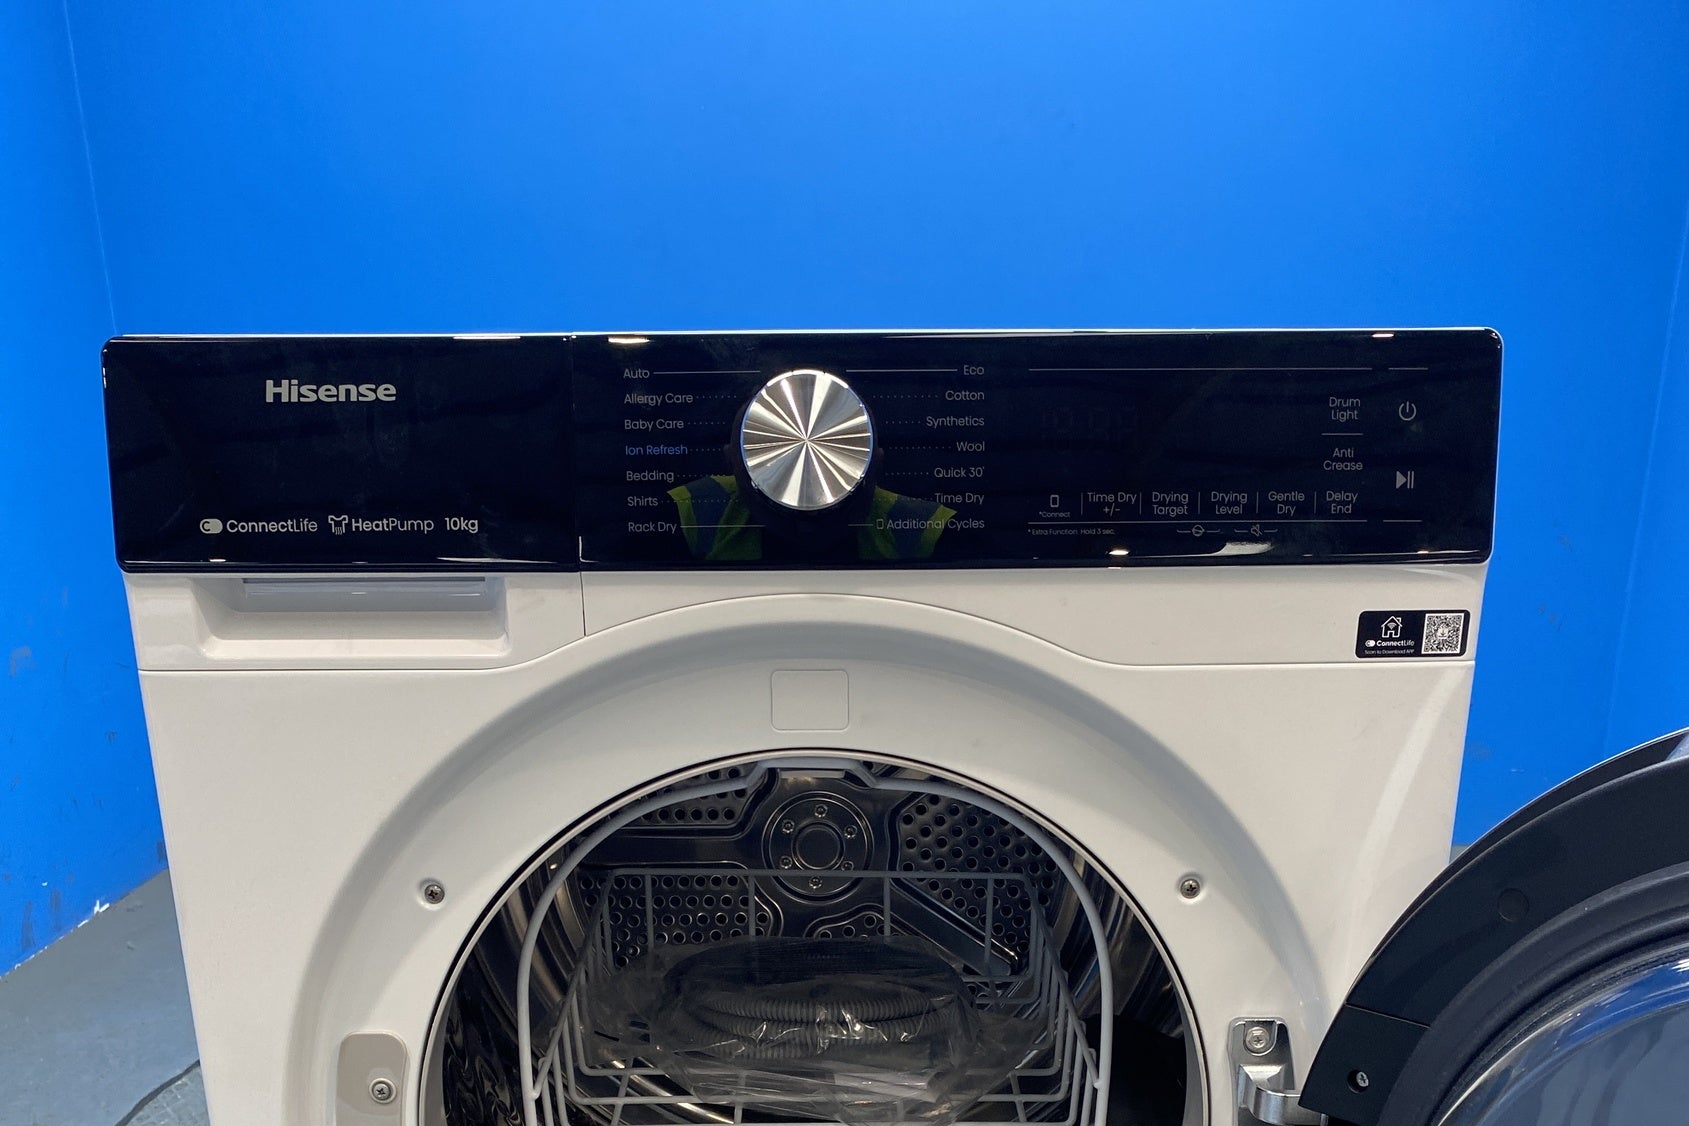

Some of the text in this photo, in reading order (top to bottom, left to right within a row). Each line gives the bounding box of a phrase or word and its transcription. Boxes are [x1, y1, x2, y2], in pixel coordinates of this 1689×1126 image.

[623, 368, 650, 379] Auto
[963, 365, 985, 376] Eco
[265, 379, 397, 403] Hisense
[945, 390, 985, 401] Cotton
[624, 393, 694, 407] Allergy Care
[1329, 396, 1361, 408] Drum
[1331, 409, 1359, 422] Light
[624, 418, 685, 432] Baby Care
[926, 416, 985, 429] Synthetics
[625, 444, 688, 456] Ion Refresh
[956, 441, 985, 452] Wool
[1332, 447, 1354, 458] Anti
[1323, 460, 1363, 471] Crease
[626, 470, 674, 483] Bedding
[934, 467, 966, 478] Quick
[627, 495, 659, 507] Shirts
[934, 492, 985, 505] Time Dry
[1087, 491, 1137, 504] Time Dry
[1152, 491, 1189, 504] Drying
[1211, 491, 1248, 504] Drying
[1268, 490, 1305, 501] Gentle
[1326, 490, 1358, 504] Delay
[1152, 505, 1188, 517] Target
[1215, 504, 1243, 515] Level
[1277, 503, 1296, 517] Dry
[1331, 503, 1352, 514] End
[226, 517, 318, 533] ConnectLife
[352, 517, 434, 534] HeatPump
[445, 517, 479, 534] 10kg
[628, 521, 677, 534] Rack Dry
[886, 518, 985, 531] Additional Cycles
[1376, 639, 1415, 647] ConnectLife
